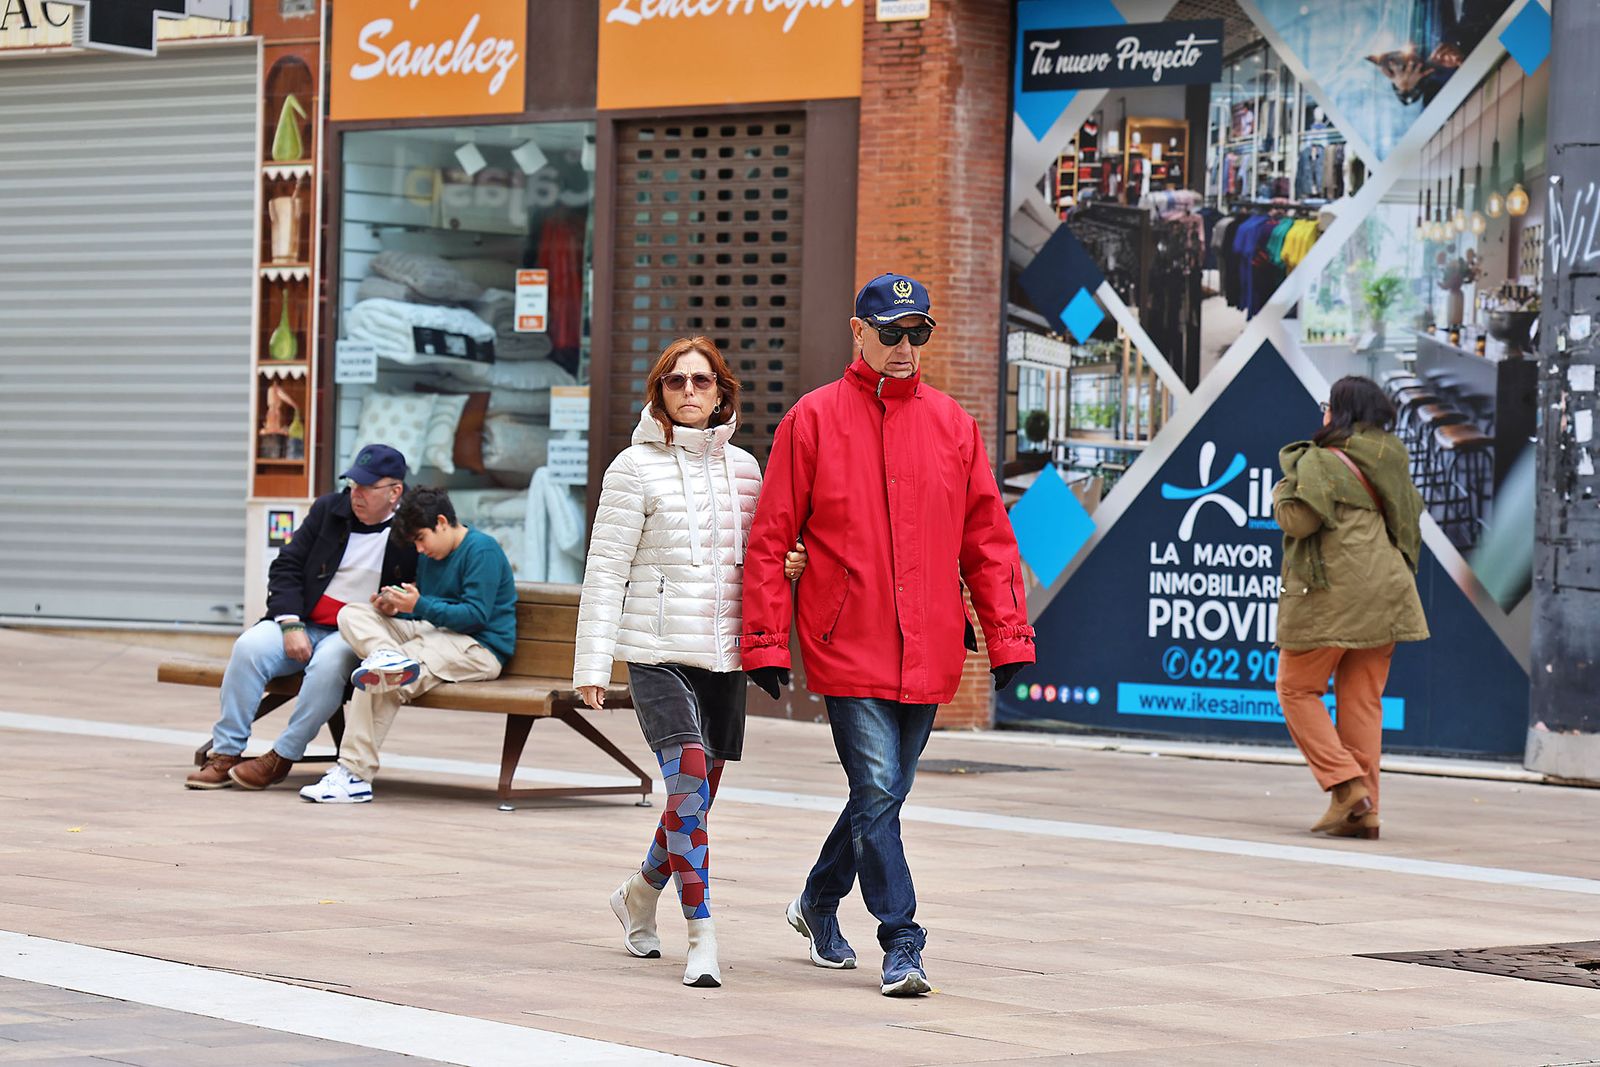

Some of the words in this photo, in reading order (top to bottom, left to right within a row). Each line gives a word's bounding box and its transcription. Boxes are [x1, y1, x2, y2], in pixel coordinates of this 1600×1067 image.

[350, 13, 519, 96] Sanchez
[1029, 39, 1060, 76] Tu
[1055, 52, 1112, 75] nuevo
[1115, 33, 1219, 83] Proyecto
[1150, 541, 1180, 565] LA
[1193, 543, 1273, 569] MAYOR
[1190, 646, 1241, 680] 622
